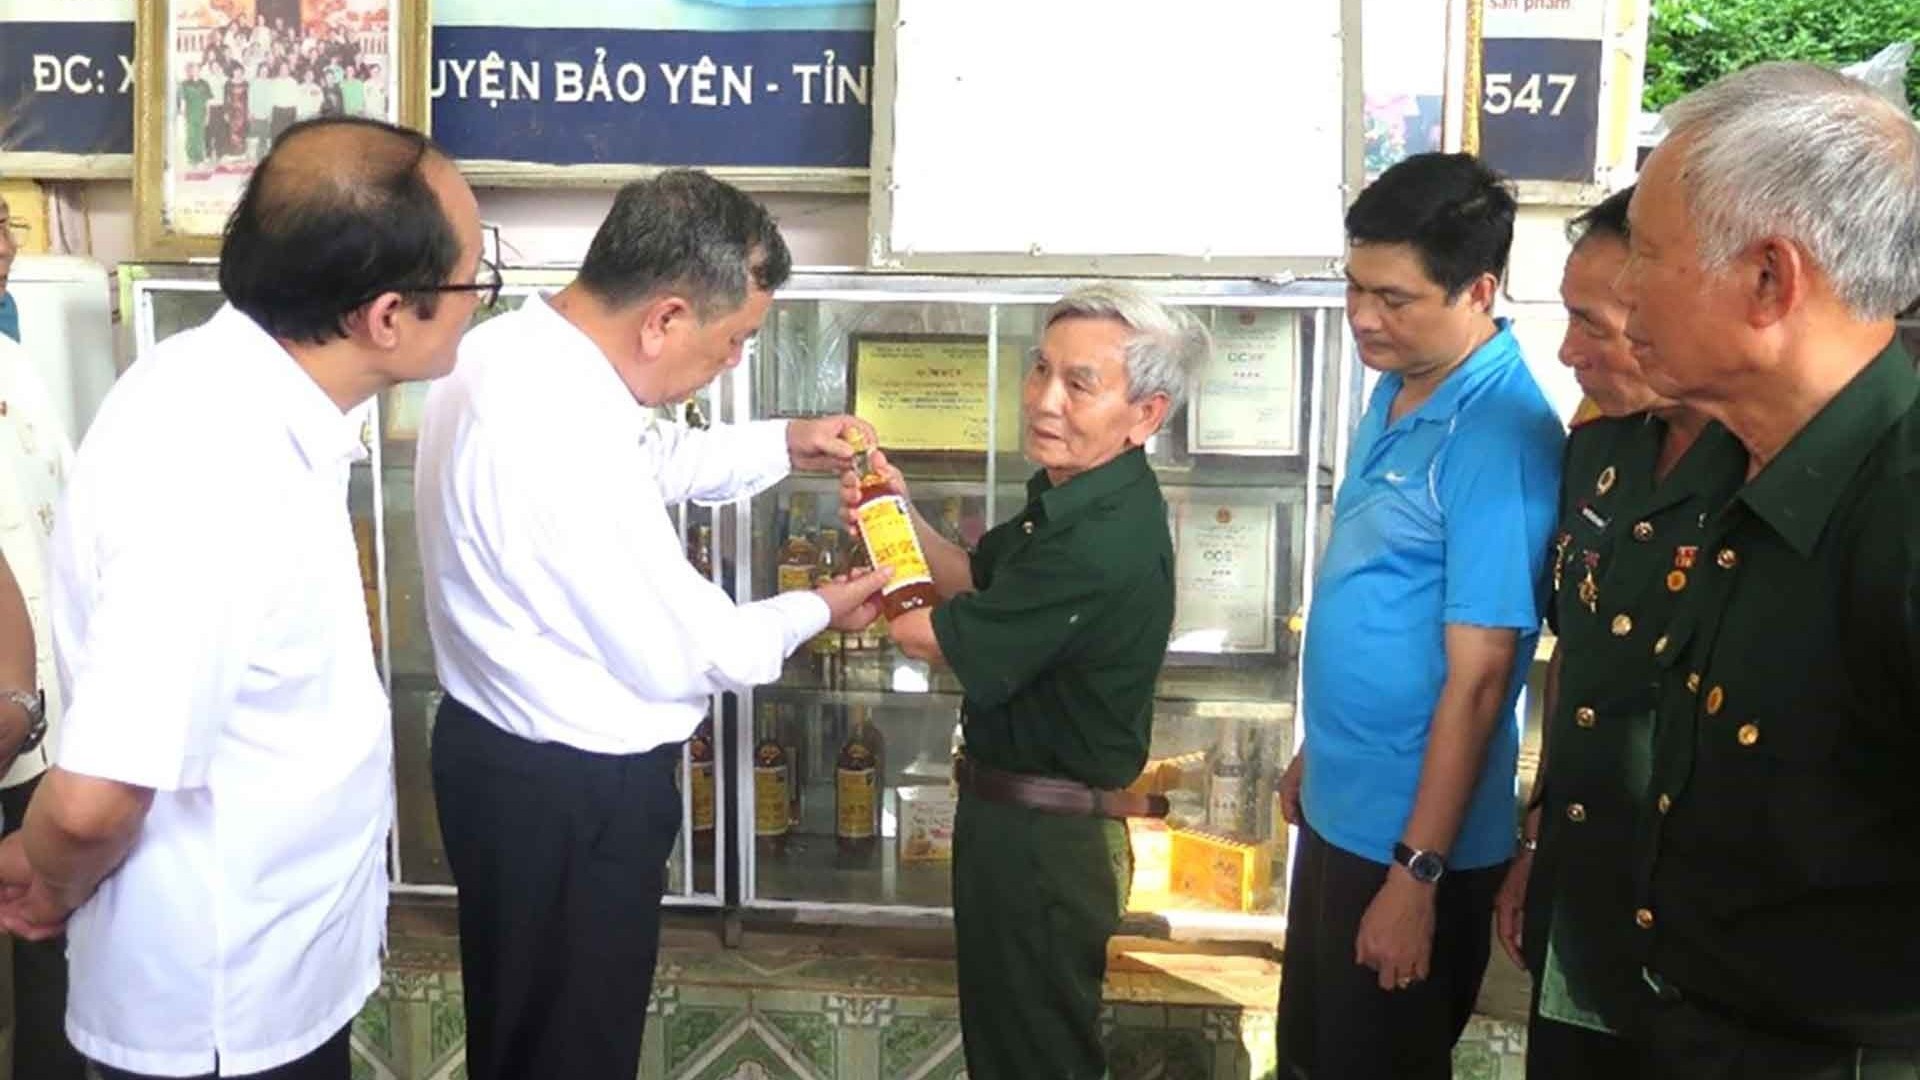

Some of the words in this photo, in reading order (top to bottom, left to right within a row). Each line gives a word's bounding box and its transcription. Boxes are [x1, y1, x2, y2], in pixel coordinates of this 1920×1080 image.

[33, 54, 104, 94] ĐC:
[554, 47, 646, 102] BẢO
[659, 55, 753, 106] YÊN
[1483, 73, 1577, 116] 547
